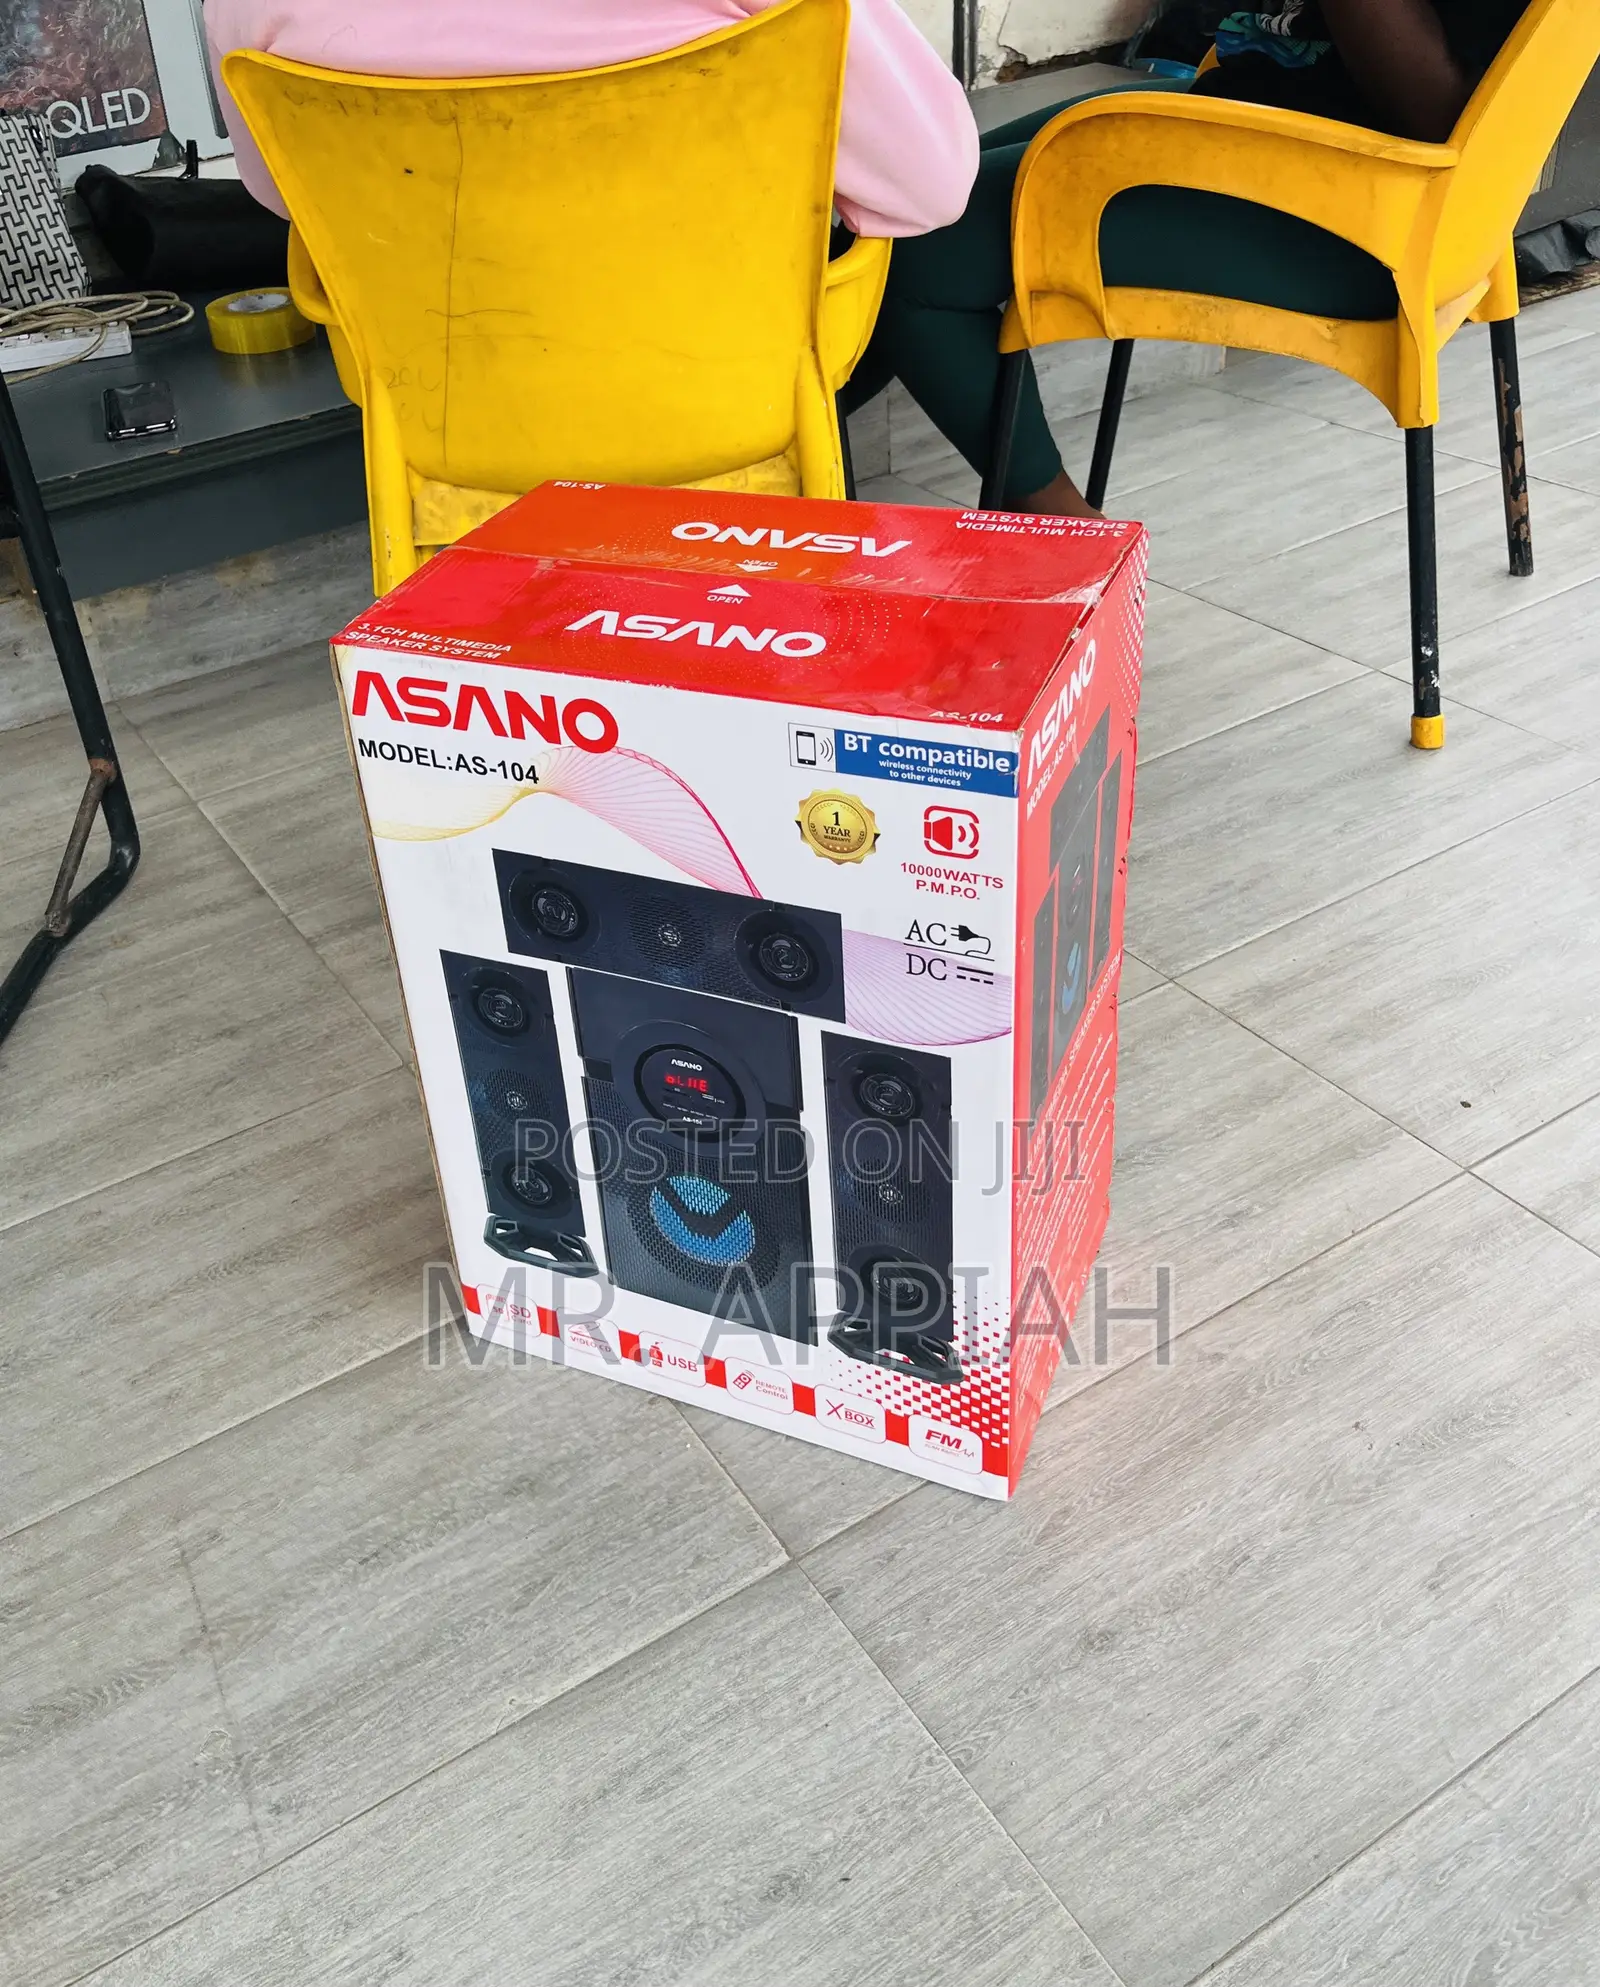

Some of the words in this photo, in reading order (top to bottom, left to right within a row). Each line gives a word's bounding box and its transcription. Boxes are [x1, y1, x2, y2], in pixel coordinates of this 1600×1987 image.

[46, 87, 151, 139] QLED
[962, 511, 1035, 524] SYSTEM
[1040, 516, 1128, 529] SPEAKER
[671, 521, 912, 557] ASANO
[955, 521, 1066, 536] MULTIMEDIA
[706, 594, 743, 604] OPEN
[357, 623, 405, 638] 3.1CH
[407, 630, 512, 653] MULTIMEDIA
[565, 610, 826, 658] ASANO
[345, 630, 424, 650] SPEAKER
[428, 644, 502, 660] SYSTEM
[352, 670, 619, 753] ASANO
[1027, 638, 1097, 790] ASANO
[358, 738, 539, 784] MODEL:AS-104
[843, 733, 872, 753] BT
[878, 742, 1011, 773] compatible
[878, 759, 915, 773] wireless
[916, 764, 972, 780] connectivity
[889, 769, 901, 778] to
[901, 770, 925, 782] other
[927, 773, 961, 787] devices
[832, 811, 840, 826] 1
[823, 825, 851, 838] YEAR
[900, 862, 1004, 889] 10000WATTS
[915, 879, 980, 900] P.M.P.O.
[905, 919, 947, 946] AC
[906, 953, 947, 981] DC
[671, 1058, 703, 1071] ASANO
[510, 1303, 531, 1319] SD
[667, 1354, 698, 1372] USB
[755, 1385, 789, 1401] Control
[925, 1429, 962, 1450] FM
